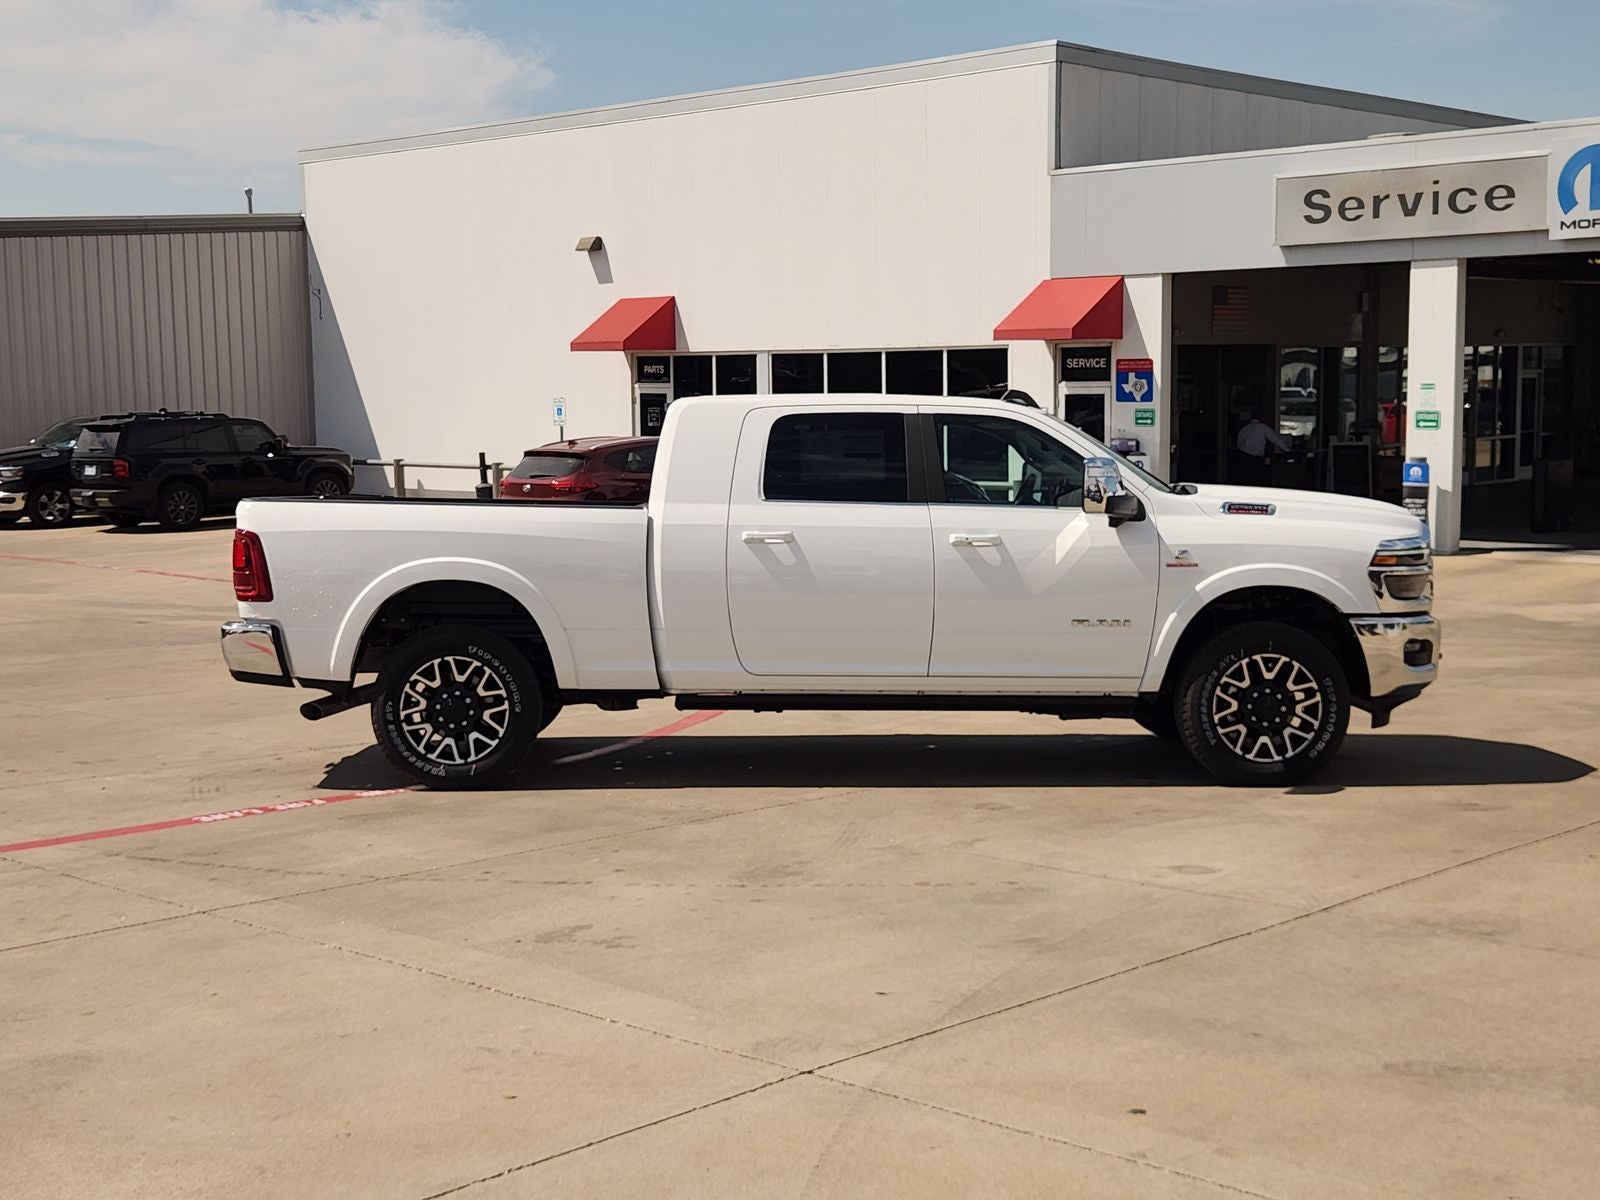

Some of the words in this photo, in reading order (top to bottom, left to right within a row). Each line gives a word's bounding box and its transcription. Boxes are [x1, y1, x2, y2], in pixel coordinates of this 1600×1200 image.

[1303, 179, 1516, 225] Service
[1066, 358, 1107, 368] SERVICE
[643, 365, 665, 374] PARTS
